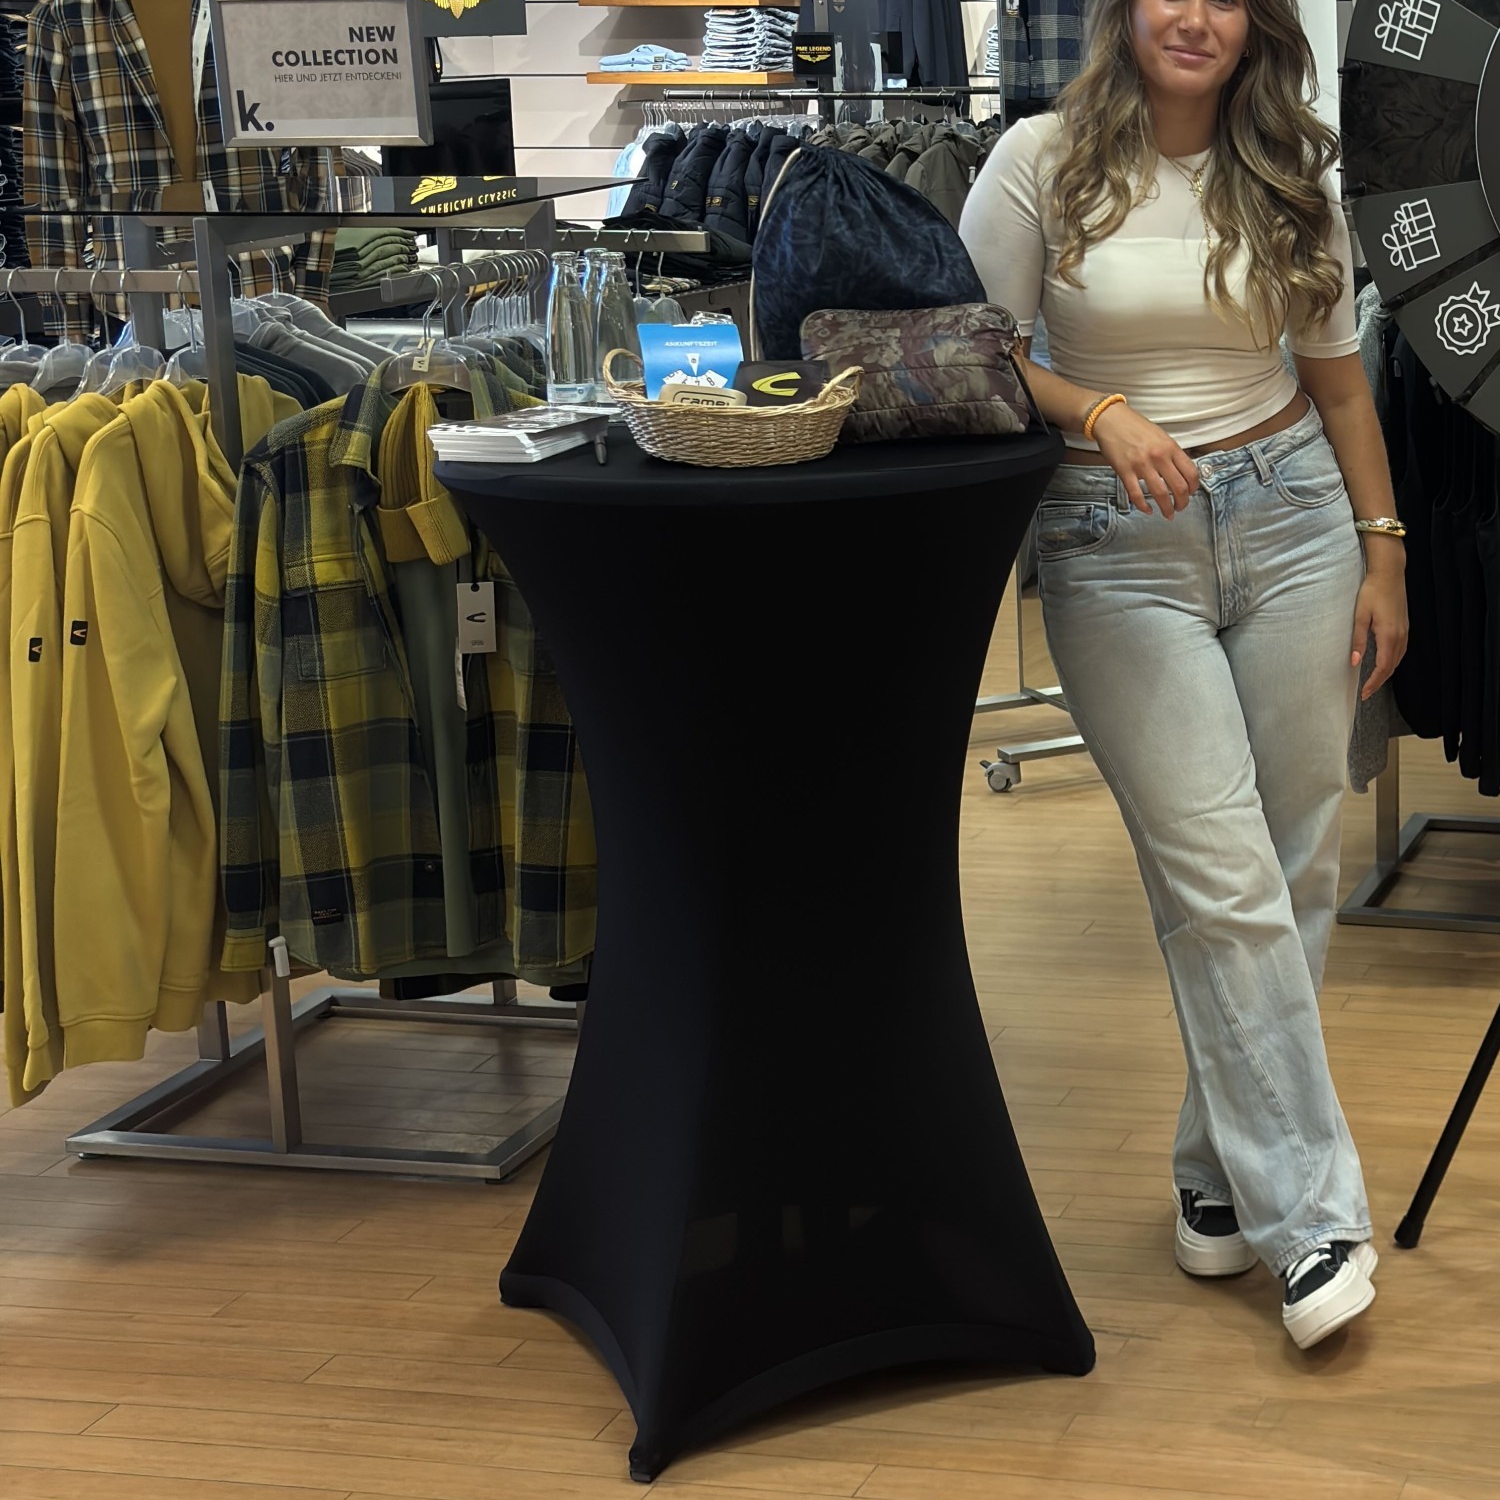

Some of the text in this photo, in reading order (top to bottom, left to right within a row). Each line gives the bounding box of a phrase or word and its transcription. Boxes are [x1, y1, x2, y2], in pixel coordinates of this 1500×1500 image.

[348, 26, 396, 43] NEW
[272, 48, 398, 67] COLLECTION
[274, 73, 294, 83] HIER
[296, 73, 317, 83] UND
[319, 72, 342, 82] JETZT
[236, 90, 275, 131] k.
[680, 397, 730, 406] came
